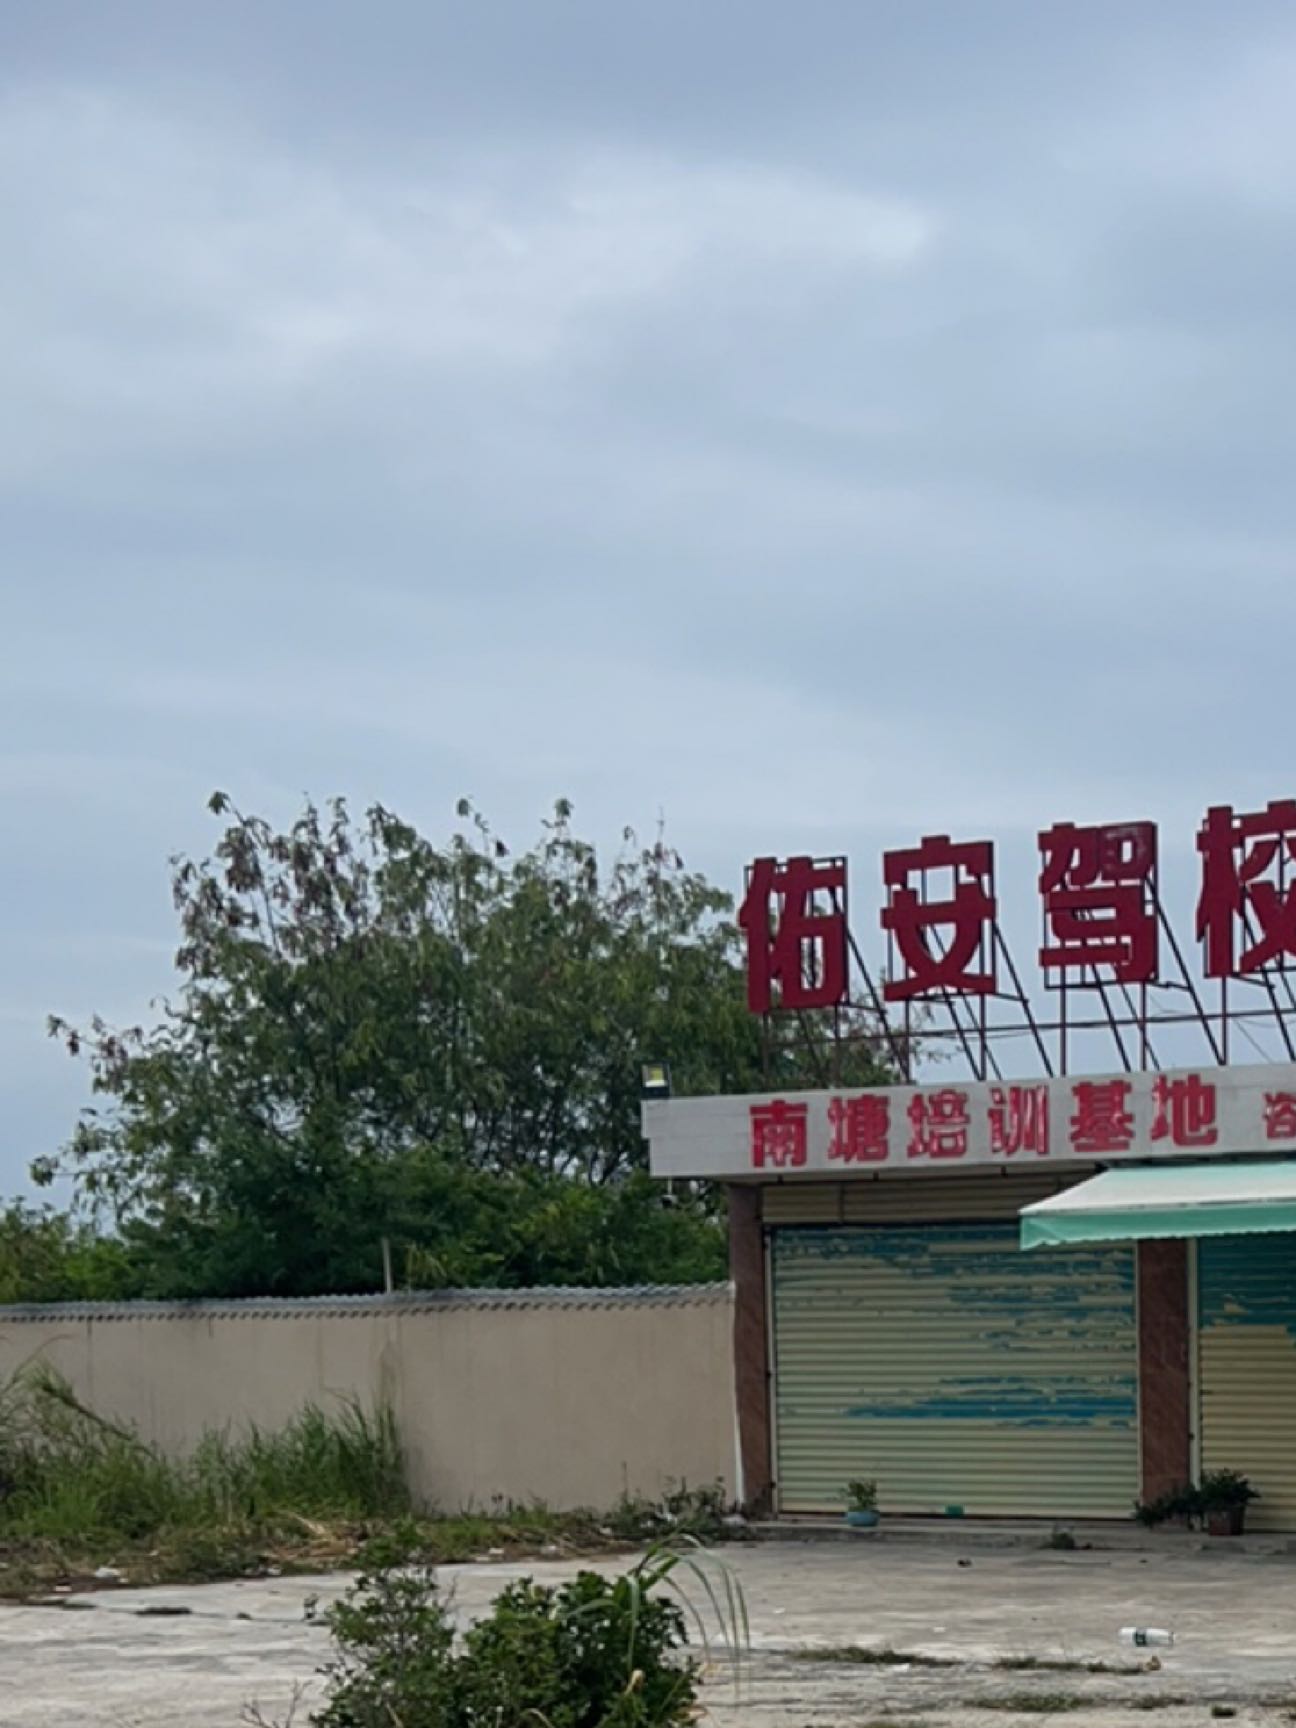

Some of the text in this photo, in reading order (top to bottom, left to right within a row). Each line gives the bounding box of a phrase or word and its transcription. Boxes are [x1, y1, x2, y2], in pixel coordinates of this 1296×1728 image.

[750, 1074, 1218, 1167] 南塘培训基地
